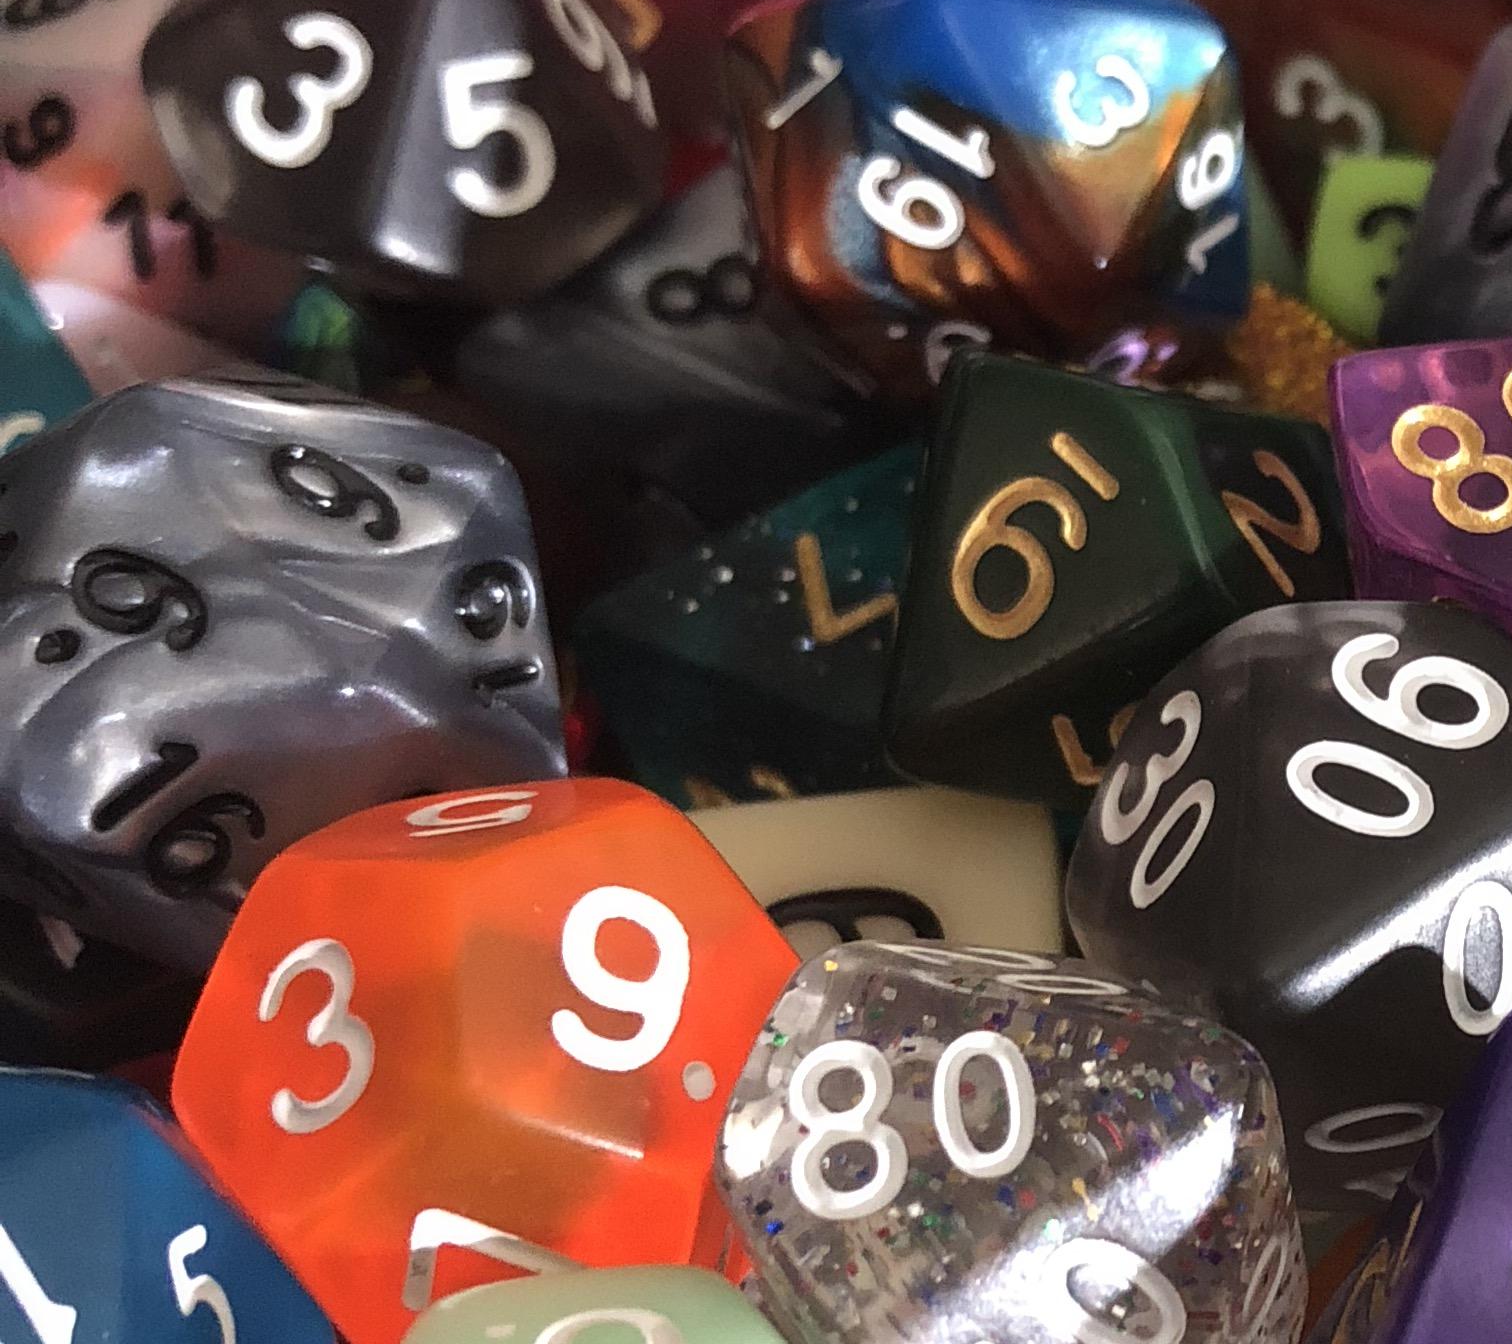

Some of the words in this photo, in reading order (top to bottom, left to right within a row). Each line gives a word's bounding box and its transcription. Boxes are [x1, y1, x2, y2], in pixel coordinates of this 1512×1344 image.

[227, 11, 372, 168] 3
[443, 52, 555, 216] 5
[1053, 54, 1150, 148] 3
[857, 106, 995, 251] 19
[645, 254, 757, 328] 8
[1222, 449, 1322, 598] 2
[1100, 689, 1216, 911] 30
[258, 938, 375, 1134] 3
[788, 1030, 1036, 1219] 80
